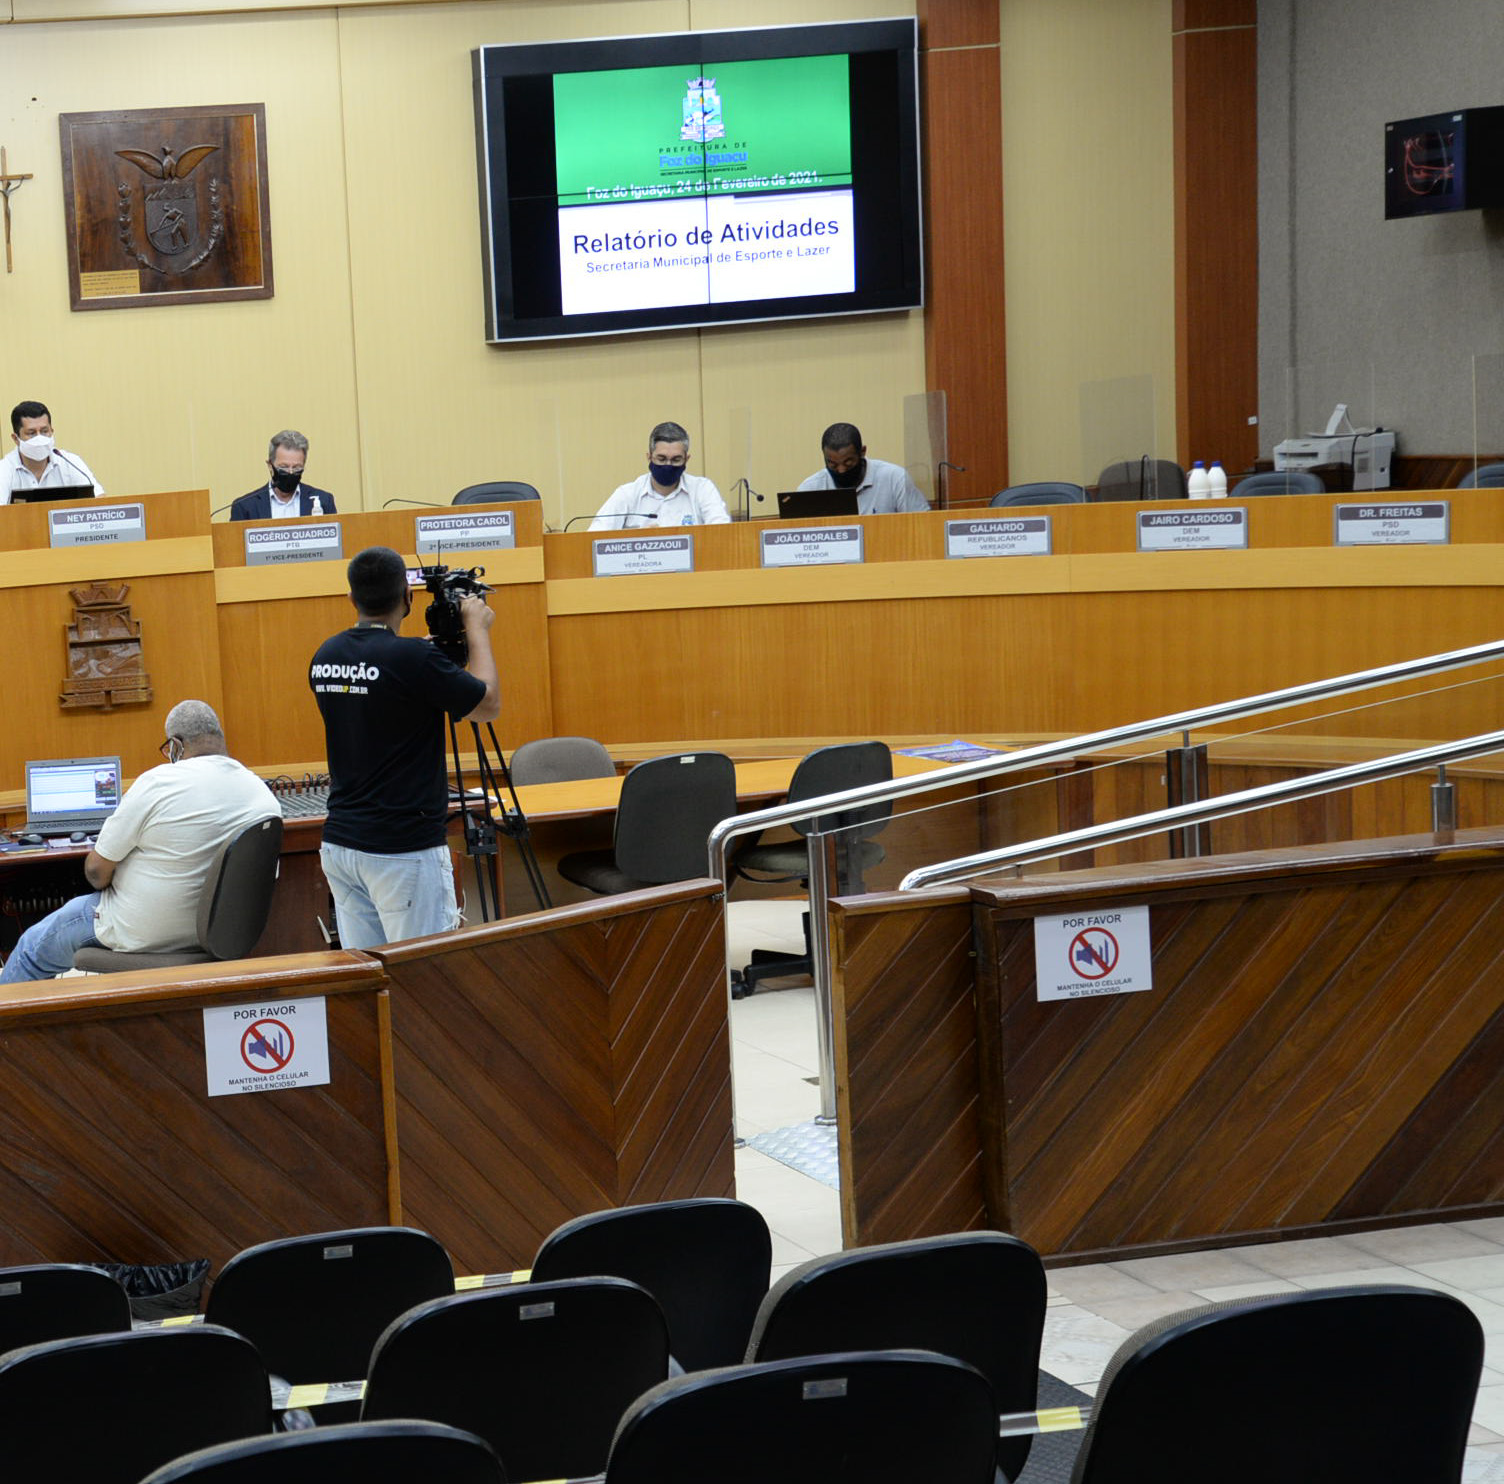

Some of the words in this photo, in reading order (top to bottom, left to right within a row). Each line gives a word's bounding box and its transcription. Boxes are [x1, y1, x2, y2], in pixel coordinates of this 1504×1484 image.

[659, 144, 727, 153] PREFEITURA
[586, 187, 609, 200] Foz
[613, 184, 628, 198] do
[677, 180, 692, 193] 24
[713, 174, 769, 190] Fevereiro
[771, 172, 787, 186] de
[790, 170, 823, 184] 2021.
[574, 230, 677, 254] Relatório
[686, 226, 712, 246] de
[720, 217, 839, 243] Atividades
[586, 258, 649, 274] Secretaria
[654, 252, 713, 268] Municipal
[717, 252, 732, 263] de
[736, 248, 783, 263] Esporte
[797, 245, 831, 257] Lazer
[67, 514, 85, 523] NEY
[87, 510, 126, 520] PATRÍCIO
[1360, 509, 1377, 518] DR.
[1379, 508, 1423, 517] FREITAS
[421, 519, 476, 530] PROTETORA
[477, 516, 508, 526] CAROL
[1150, 516, 1181, 525] JAIRO
[1182, 514, 1234, 524] CARDOSO
[970, 523, 1025, 533] GALHARDO
[76, 534, 119, 542] PRESIDENTE
[250, 532, 290, 542] ROGÉRIO
[292, 529, 336, 539] QUADROS
[774, 534, 800, 544] JOÃO
[802, 532, 849, 542] MORALES
[968, 535, 1027, 543] REPUBLICANOS
[605, 543, 632, 553] ANICE
[634, 541, 682, 551] GAZZAOUI
[272, 552, 324, 561] VICE-PRESIDENTE
[312, 662, 380, 683] PRODUÇÃO
[1063, 918, 1085, 928] POR
[1088, 914, 1122, 926] FAVOR
[1057, 982, 1094, 992] MANTENHA
[1102, 978, 1132, 987] CELULAR
[1081, 987, 1121, 996] SILENCIOSO
[234, 1010, 257, 1020] POR
[260, 1005, 296, 1018] FAVOR
[229, 1076, 268, 1086] MANTENHA
[276, 1072, 309, 1081] CELULAR
[255, 1080, 296, 1091] SILENCIOSO
